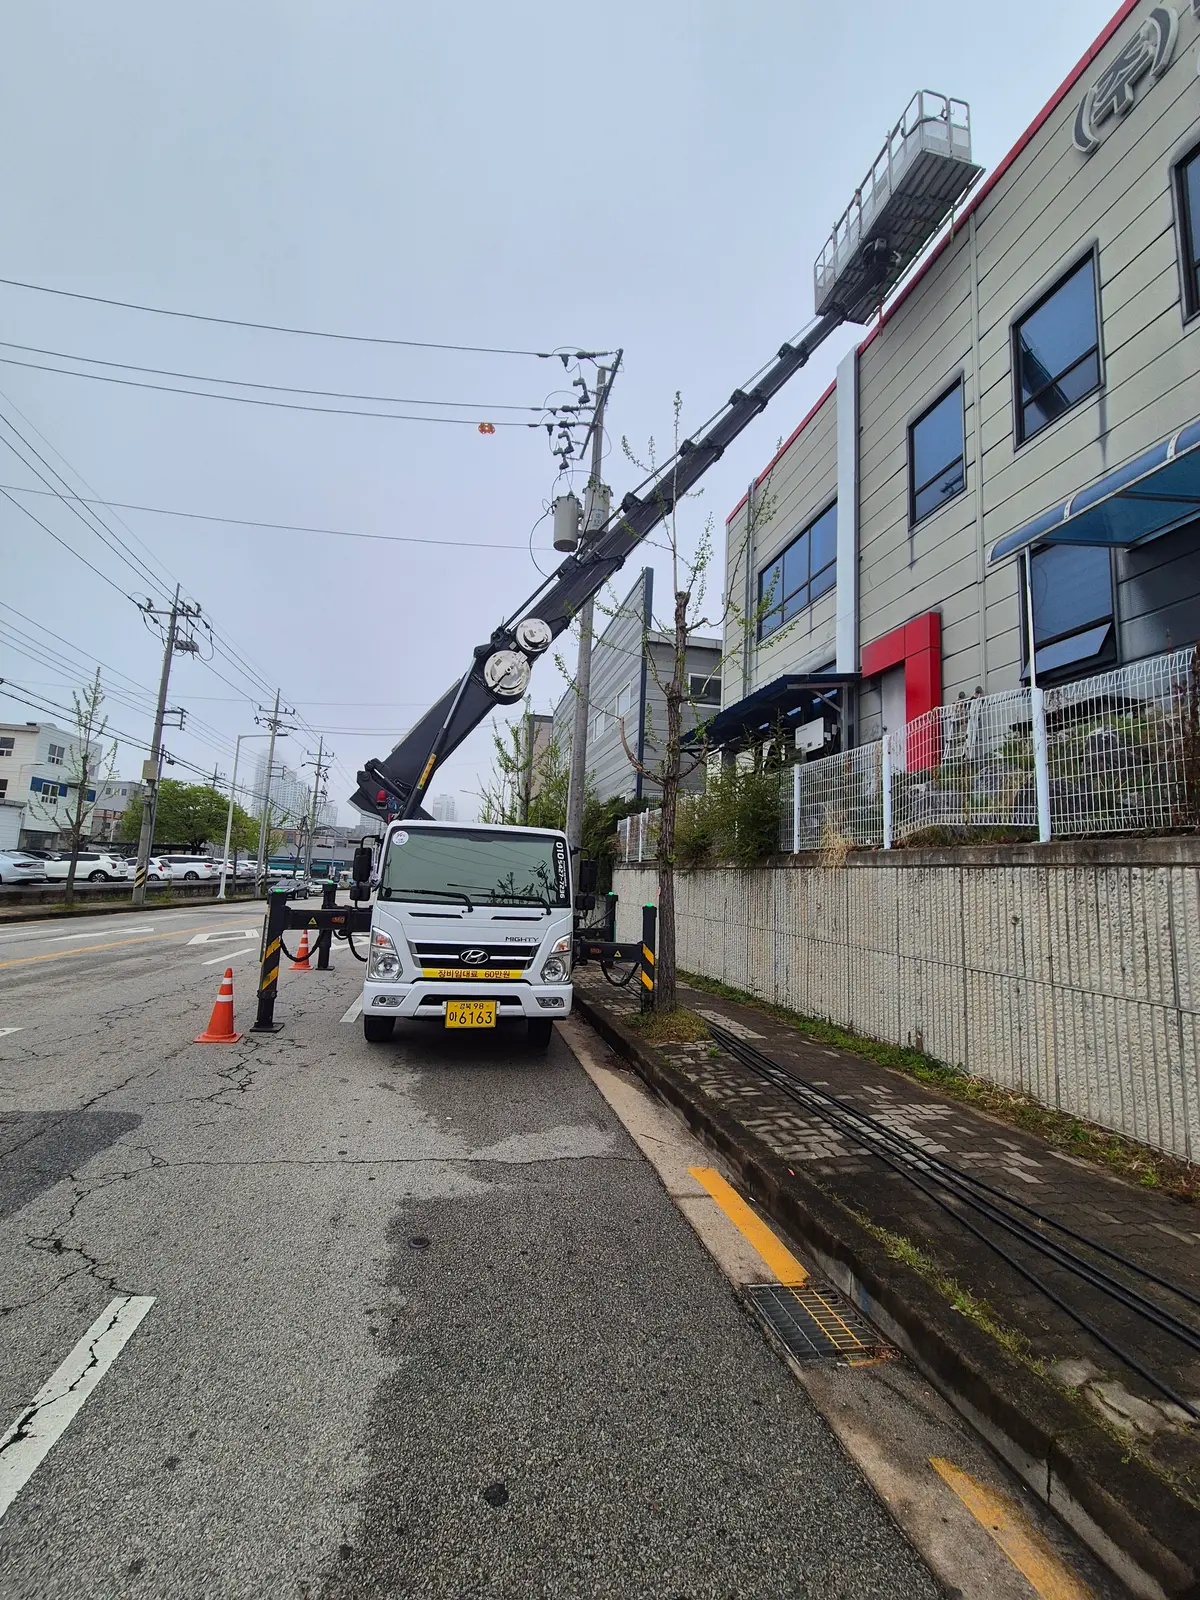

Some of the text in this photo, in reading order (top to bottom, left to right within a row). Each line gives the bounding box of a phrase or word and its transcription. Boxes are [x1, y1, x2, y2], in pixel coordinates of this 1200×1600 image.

[1072, 7, 1179, 153] (주)
[555, 841, 565, 860] 010
[438, 969, 511, 979] 장비임대료 60만원
[474, 1002, 484, 1010] 98
[449, 1011, 493, 1025] 아6163
